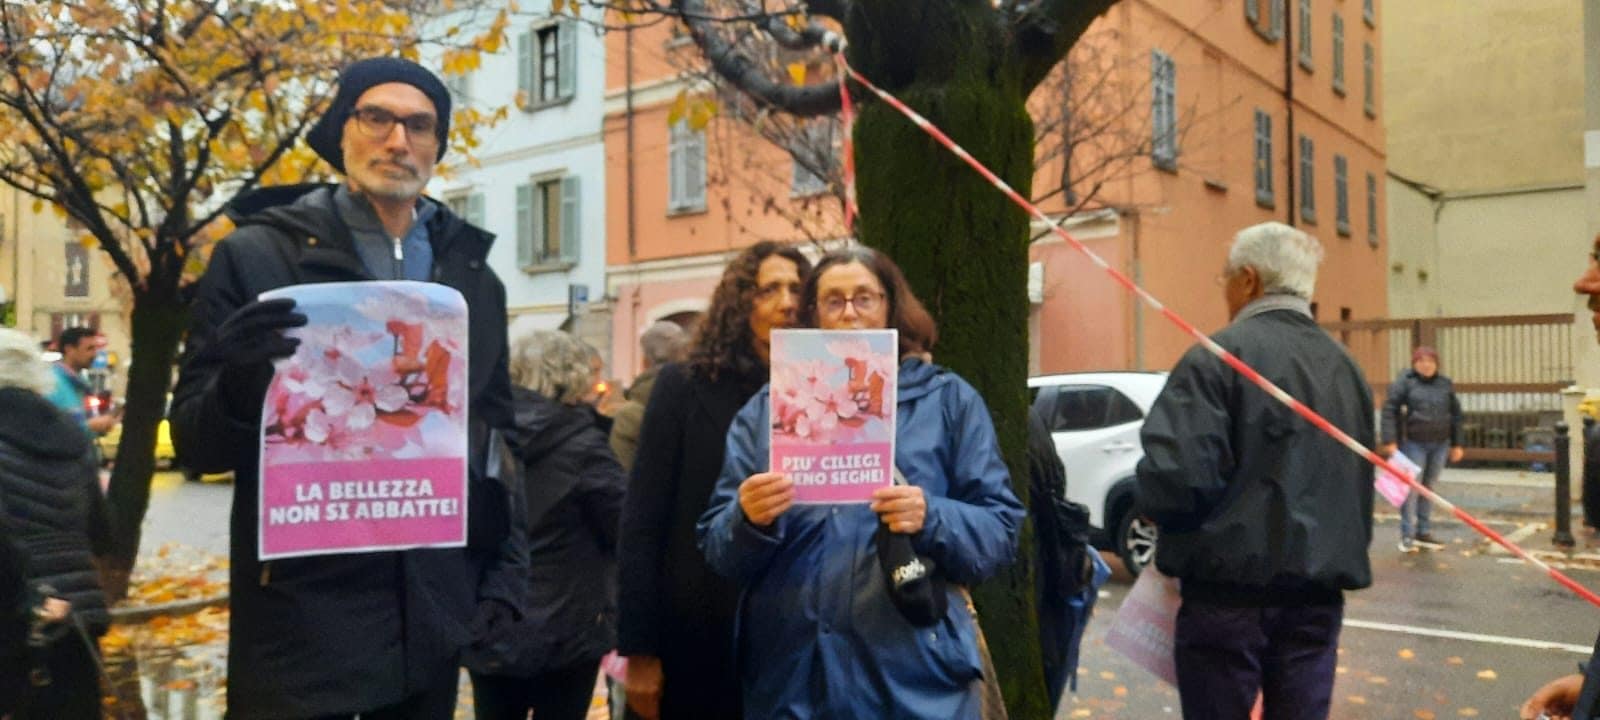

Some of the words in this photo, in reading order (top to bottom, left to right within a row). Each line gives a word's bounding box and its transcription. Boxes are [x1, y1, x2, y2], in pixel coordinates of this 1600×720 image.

[821, 454, 881, 469] CILIEGI
[831, 470, 884, 485] SEGHE!
[295, 484, 323, 502] LA
[329, 480, 433, 499] BELLEZZA
[269, 506, 320, 525] NON
[325, 503, 349, 522] SI
[355, 498, 459, 519] ABBATTE!
